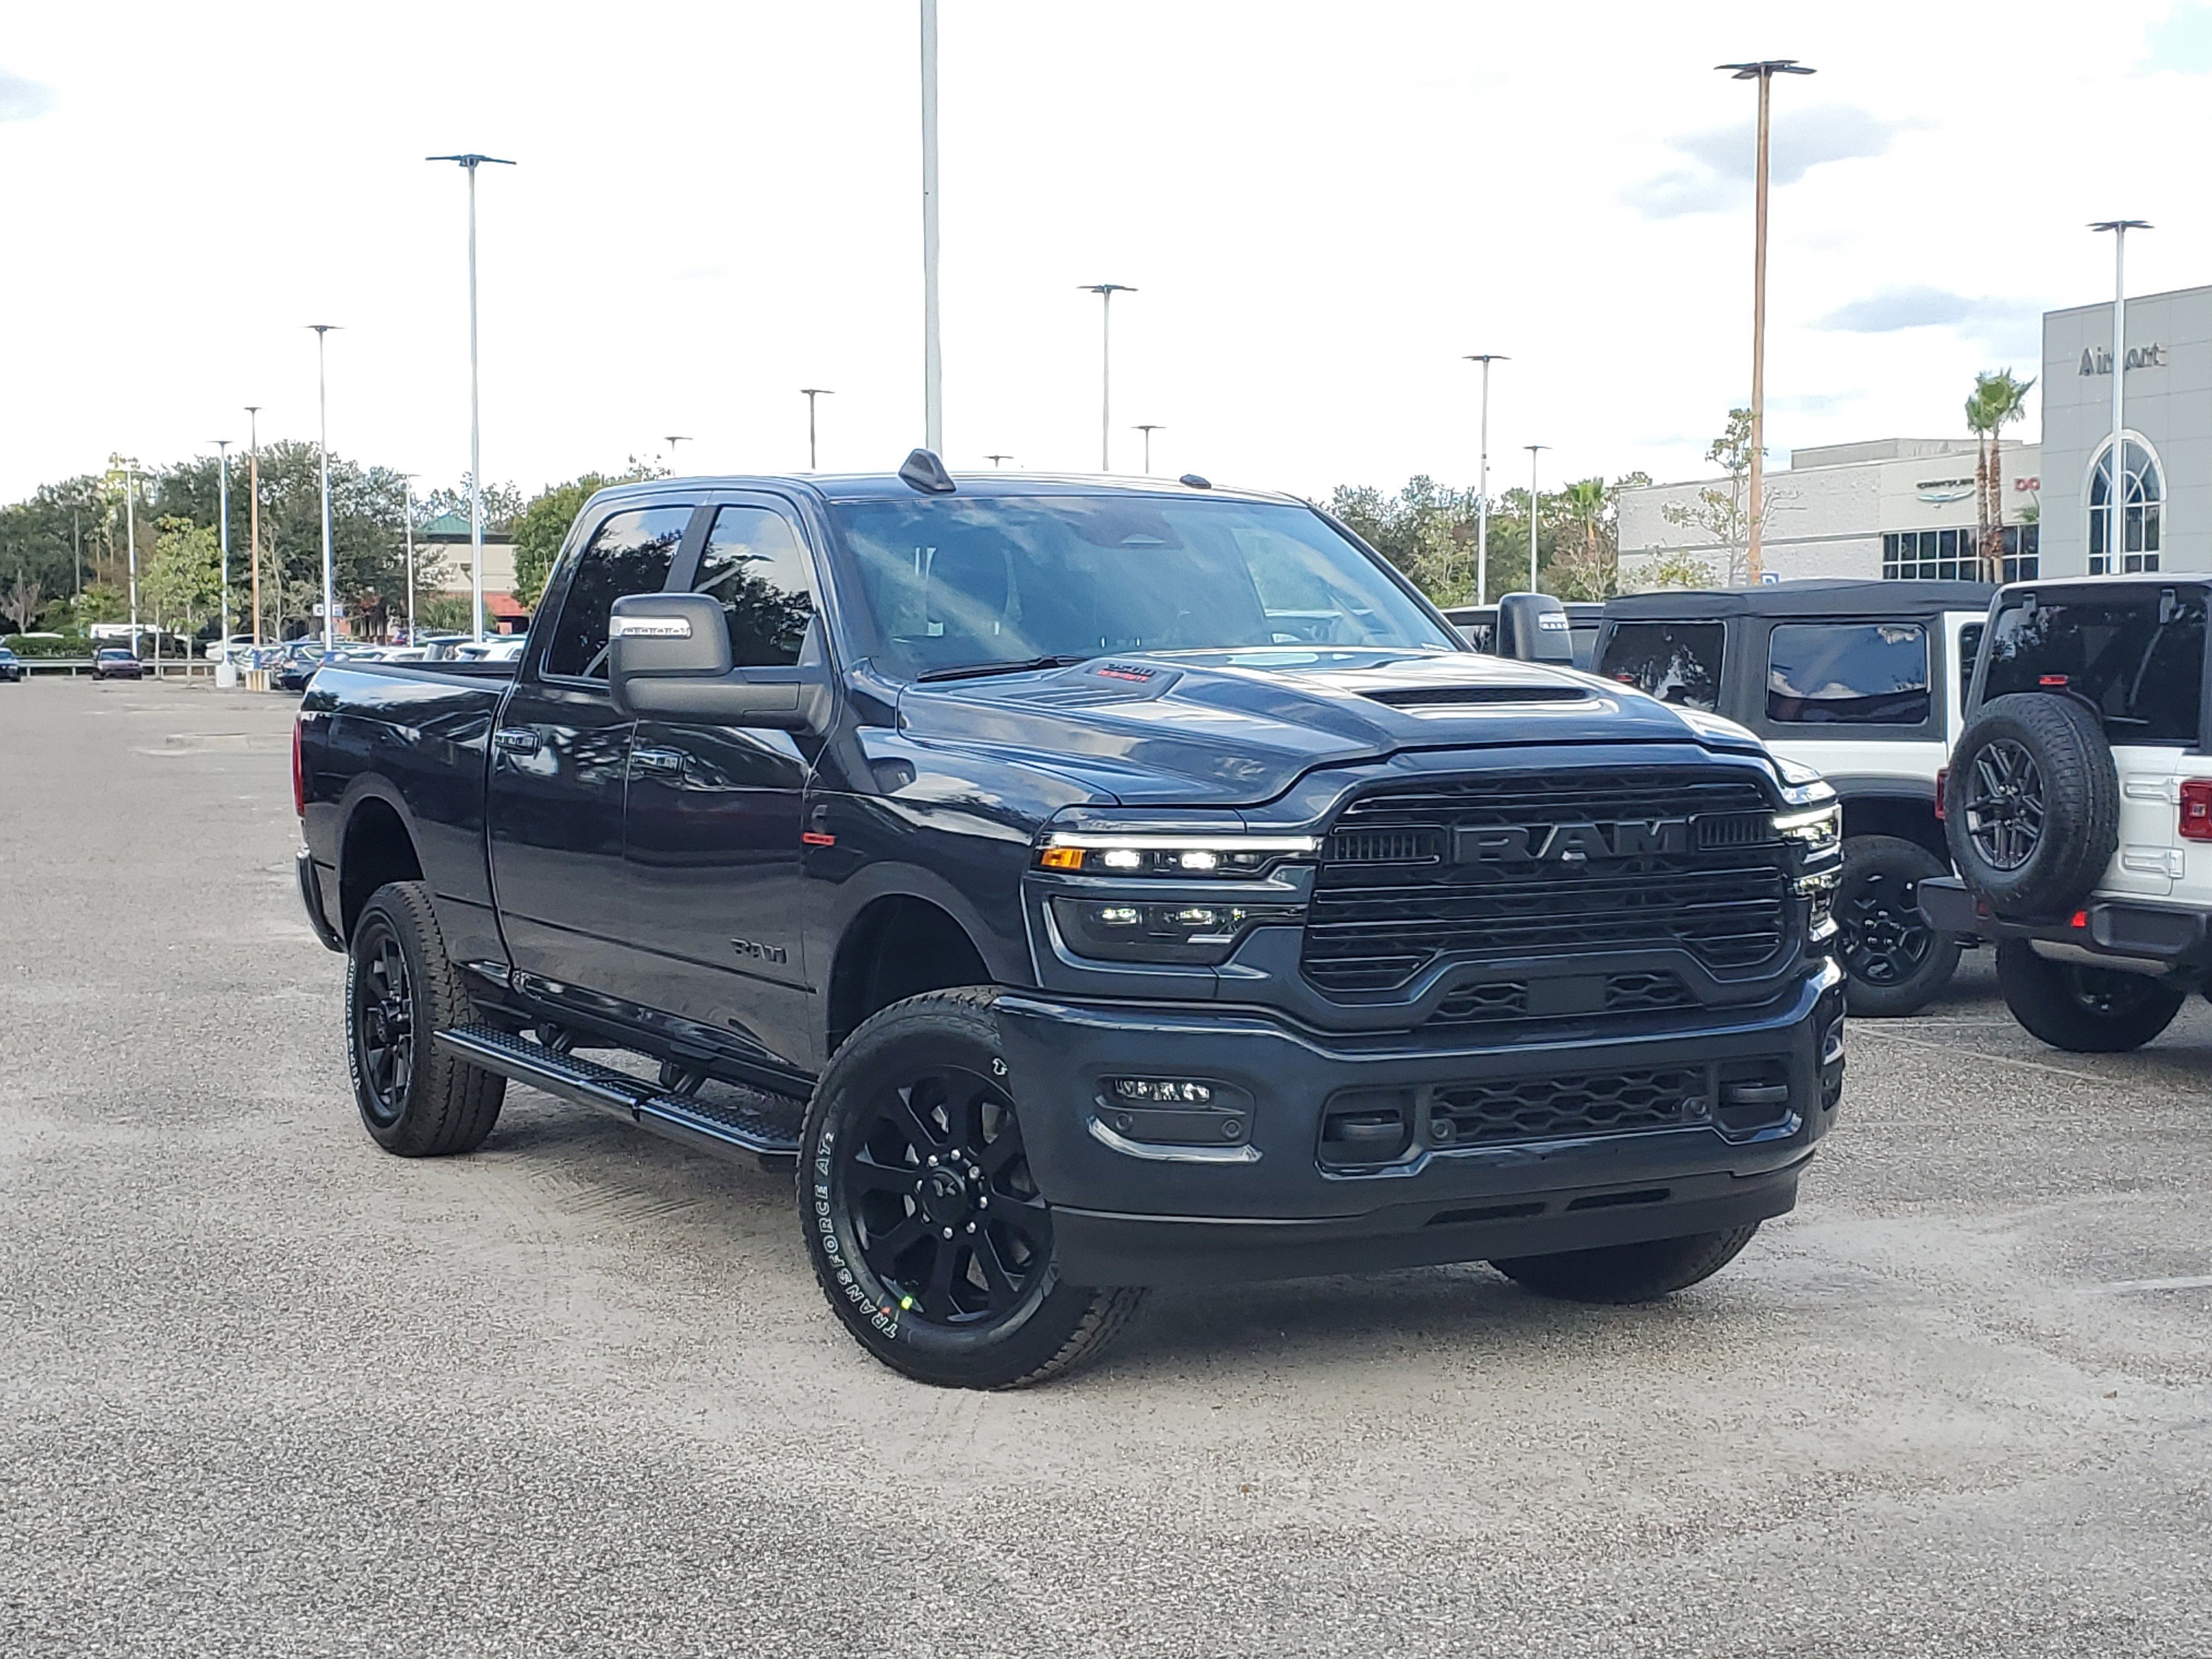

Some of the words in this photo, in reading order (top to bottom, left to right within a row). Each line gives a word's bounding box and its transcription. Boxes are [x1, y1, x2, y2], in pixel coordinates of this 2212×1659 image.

[2079, 342, 2166, 376] Airort
[1453, 820, 1686, 862] RAM
[814, 1183, 900, 1339] TRANSFORCE
